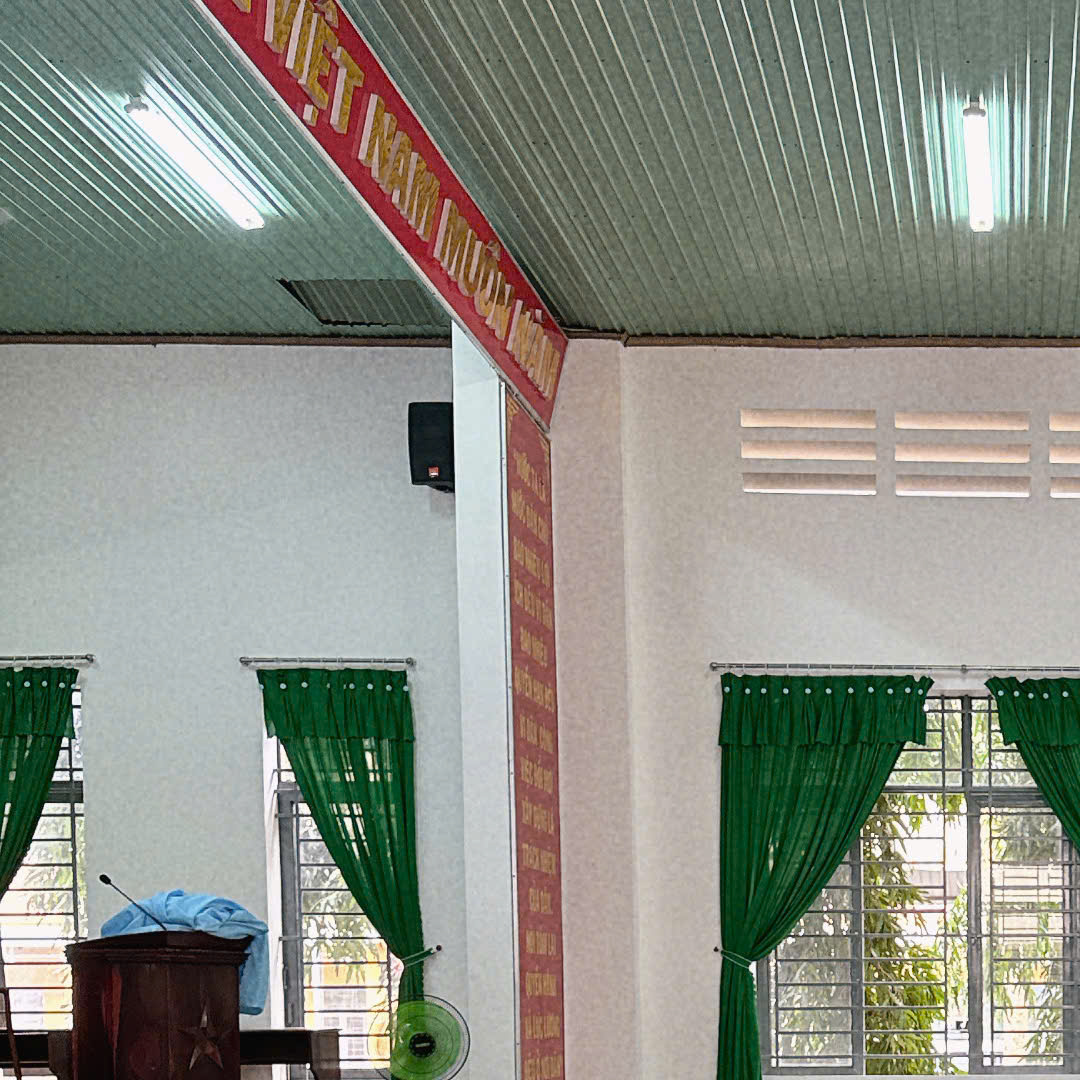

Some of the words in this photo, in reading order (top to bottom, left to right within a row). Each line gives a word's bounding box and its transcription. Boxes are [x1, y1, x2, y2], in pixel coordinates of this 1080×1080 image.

[264, 0, 365, 134] VIỆT
[358, 93, 440, 243] NAM
[433, 198, 515, 341] MUÔN
